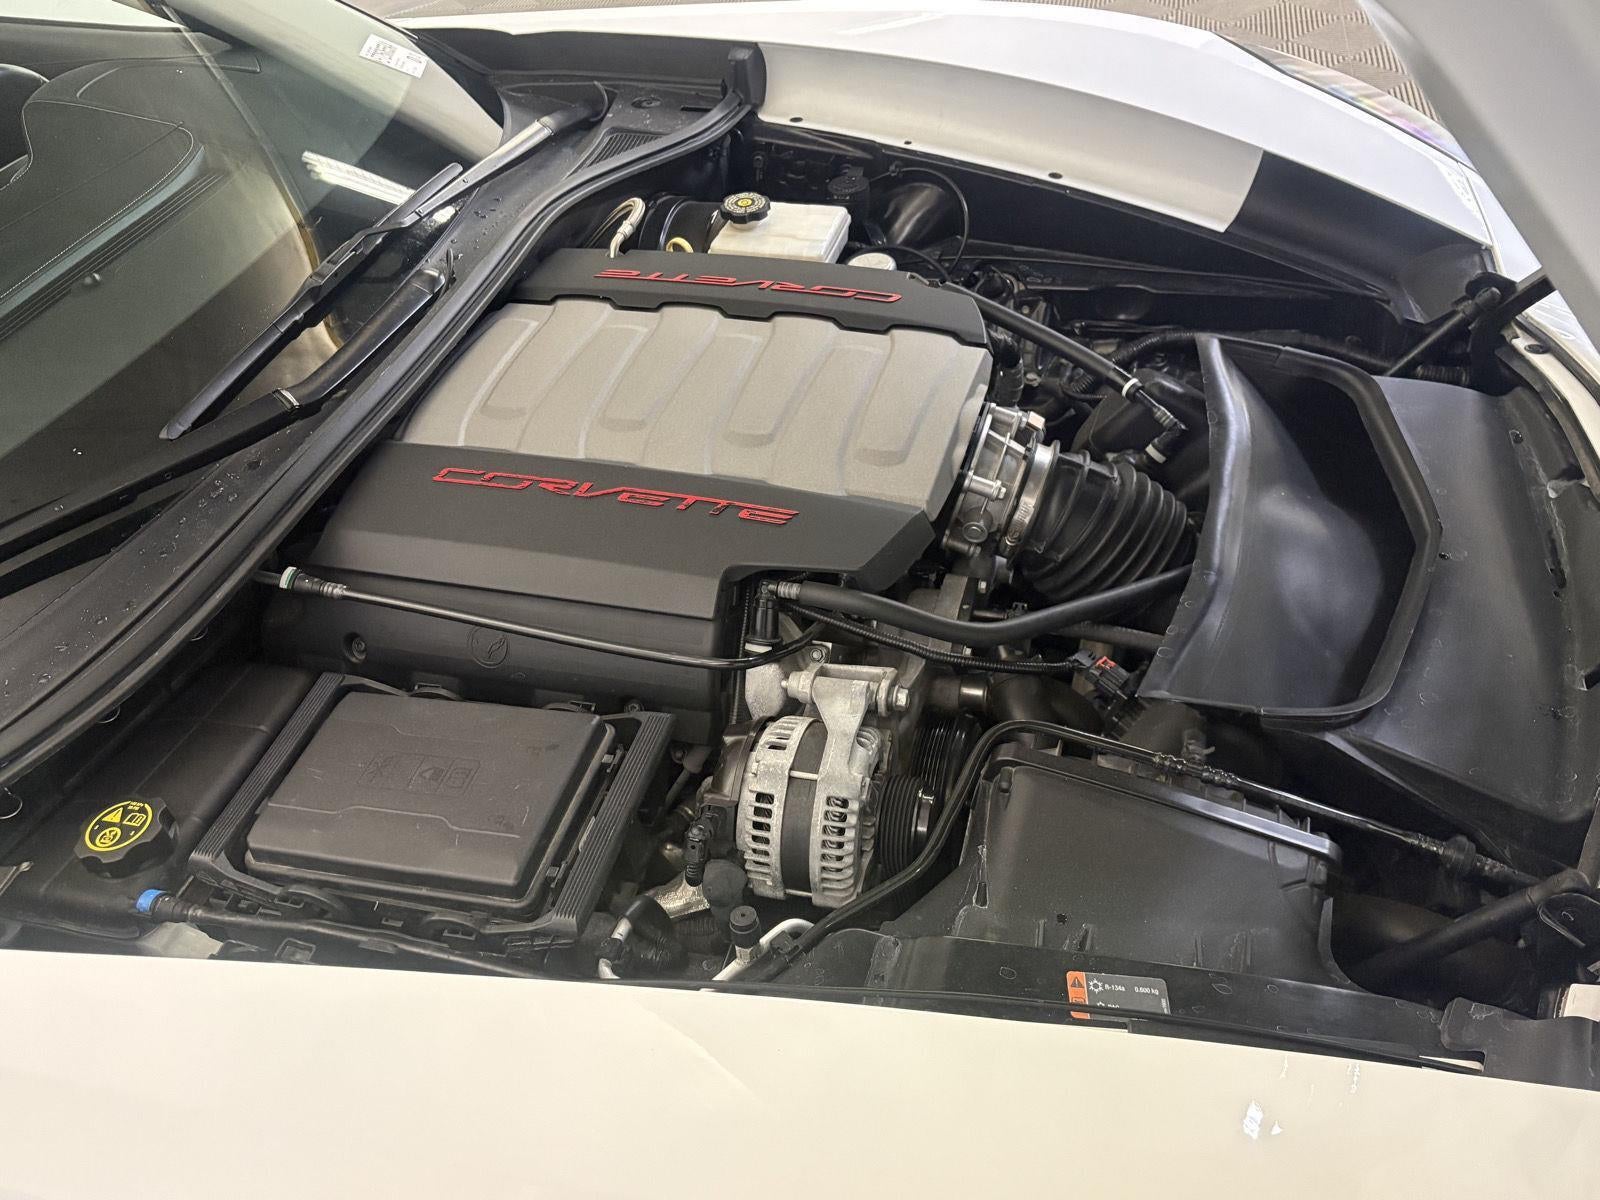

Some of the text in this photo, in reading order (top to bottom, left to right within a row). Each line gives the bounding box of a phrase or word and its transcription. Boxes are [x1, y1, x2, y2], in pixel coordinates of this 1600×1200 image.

[594, 269, 902, 303] CORVETTE
[432, 467, 800, 526] CORVETTE
[1104, 983, 1126, 992] R-134a
